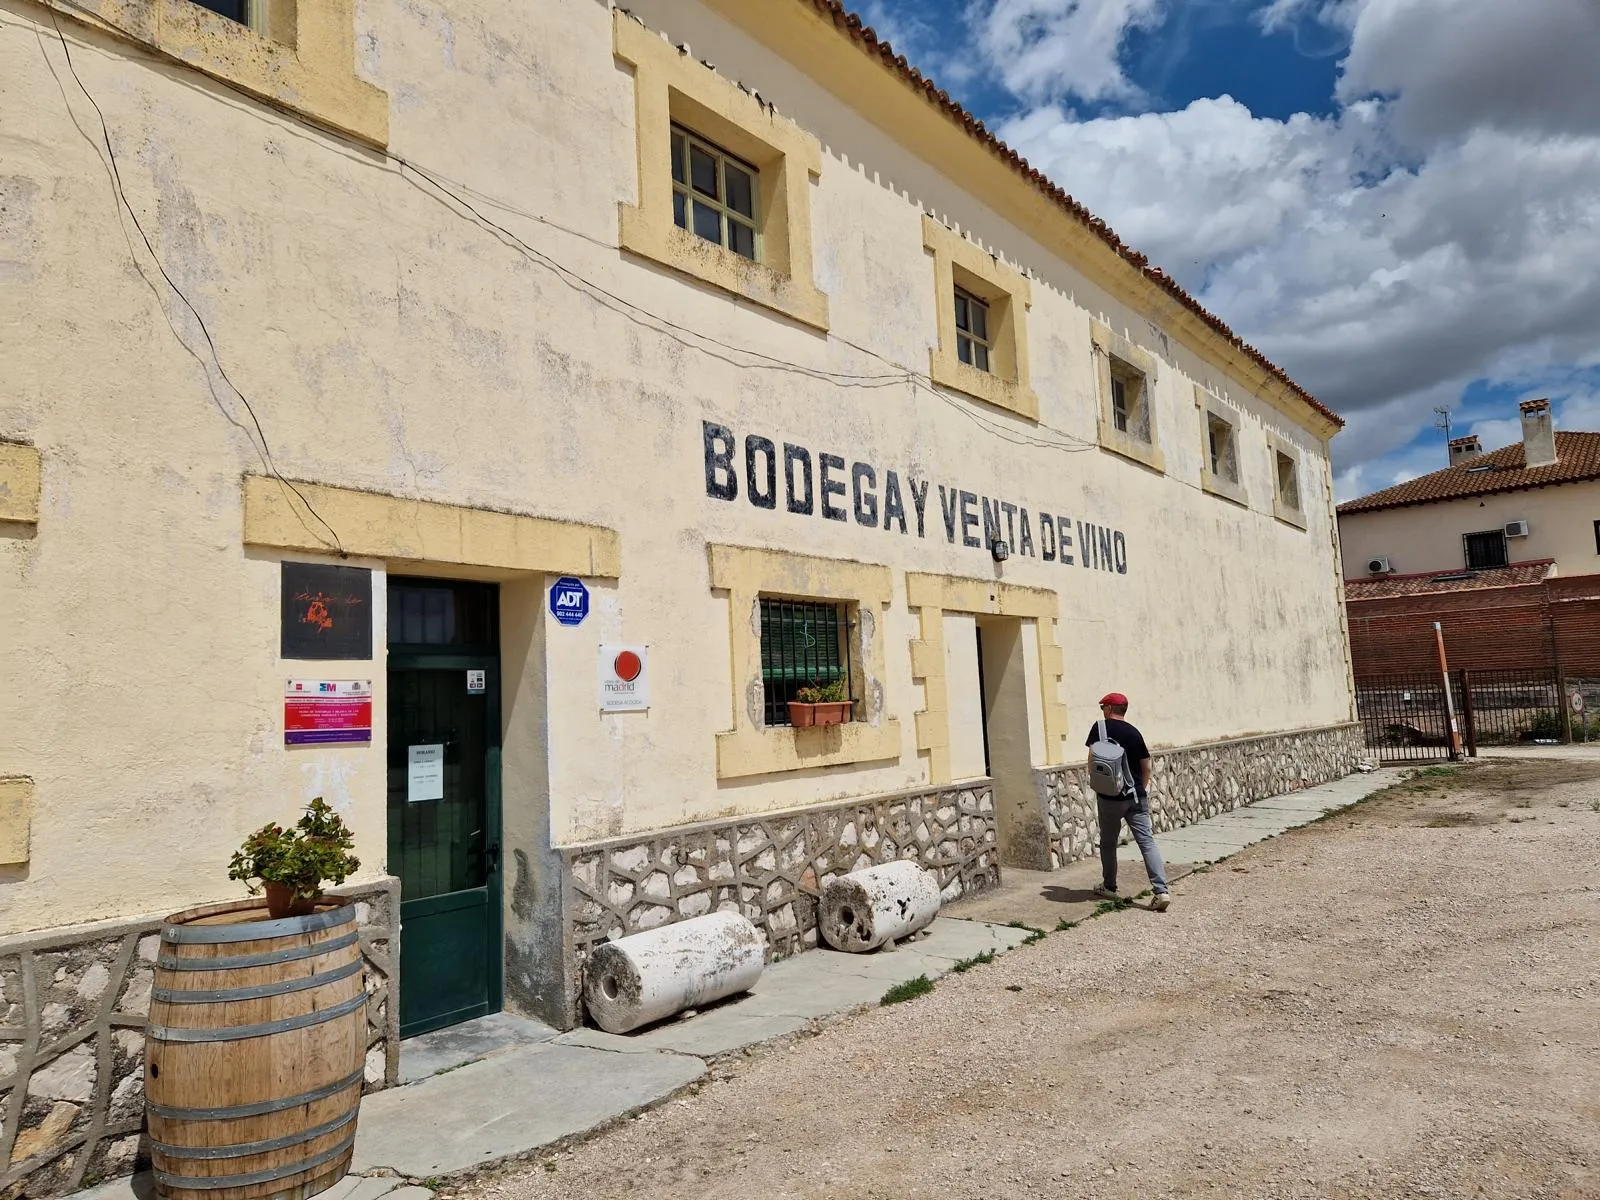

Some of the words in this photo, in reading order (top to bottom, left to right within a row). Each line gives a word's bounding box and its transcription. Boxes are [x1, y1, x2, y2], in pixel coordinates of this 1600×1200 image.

[702, 420, 908, 534] BODEGA
[908, 476, 929, 538] Y
[938, 485, 1035, 558] VENTA
[1039, 512, 1074, 566] DE
[1077, 521, 1128, 575] VINO
[556, 591, 583, 607] ADT
[604, 681, 635, 692] madrid
